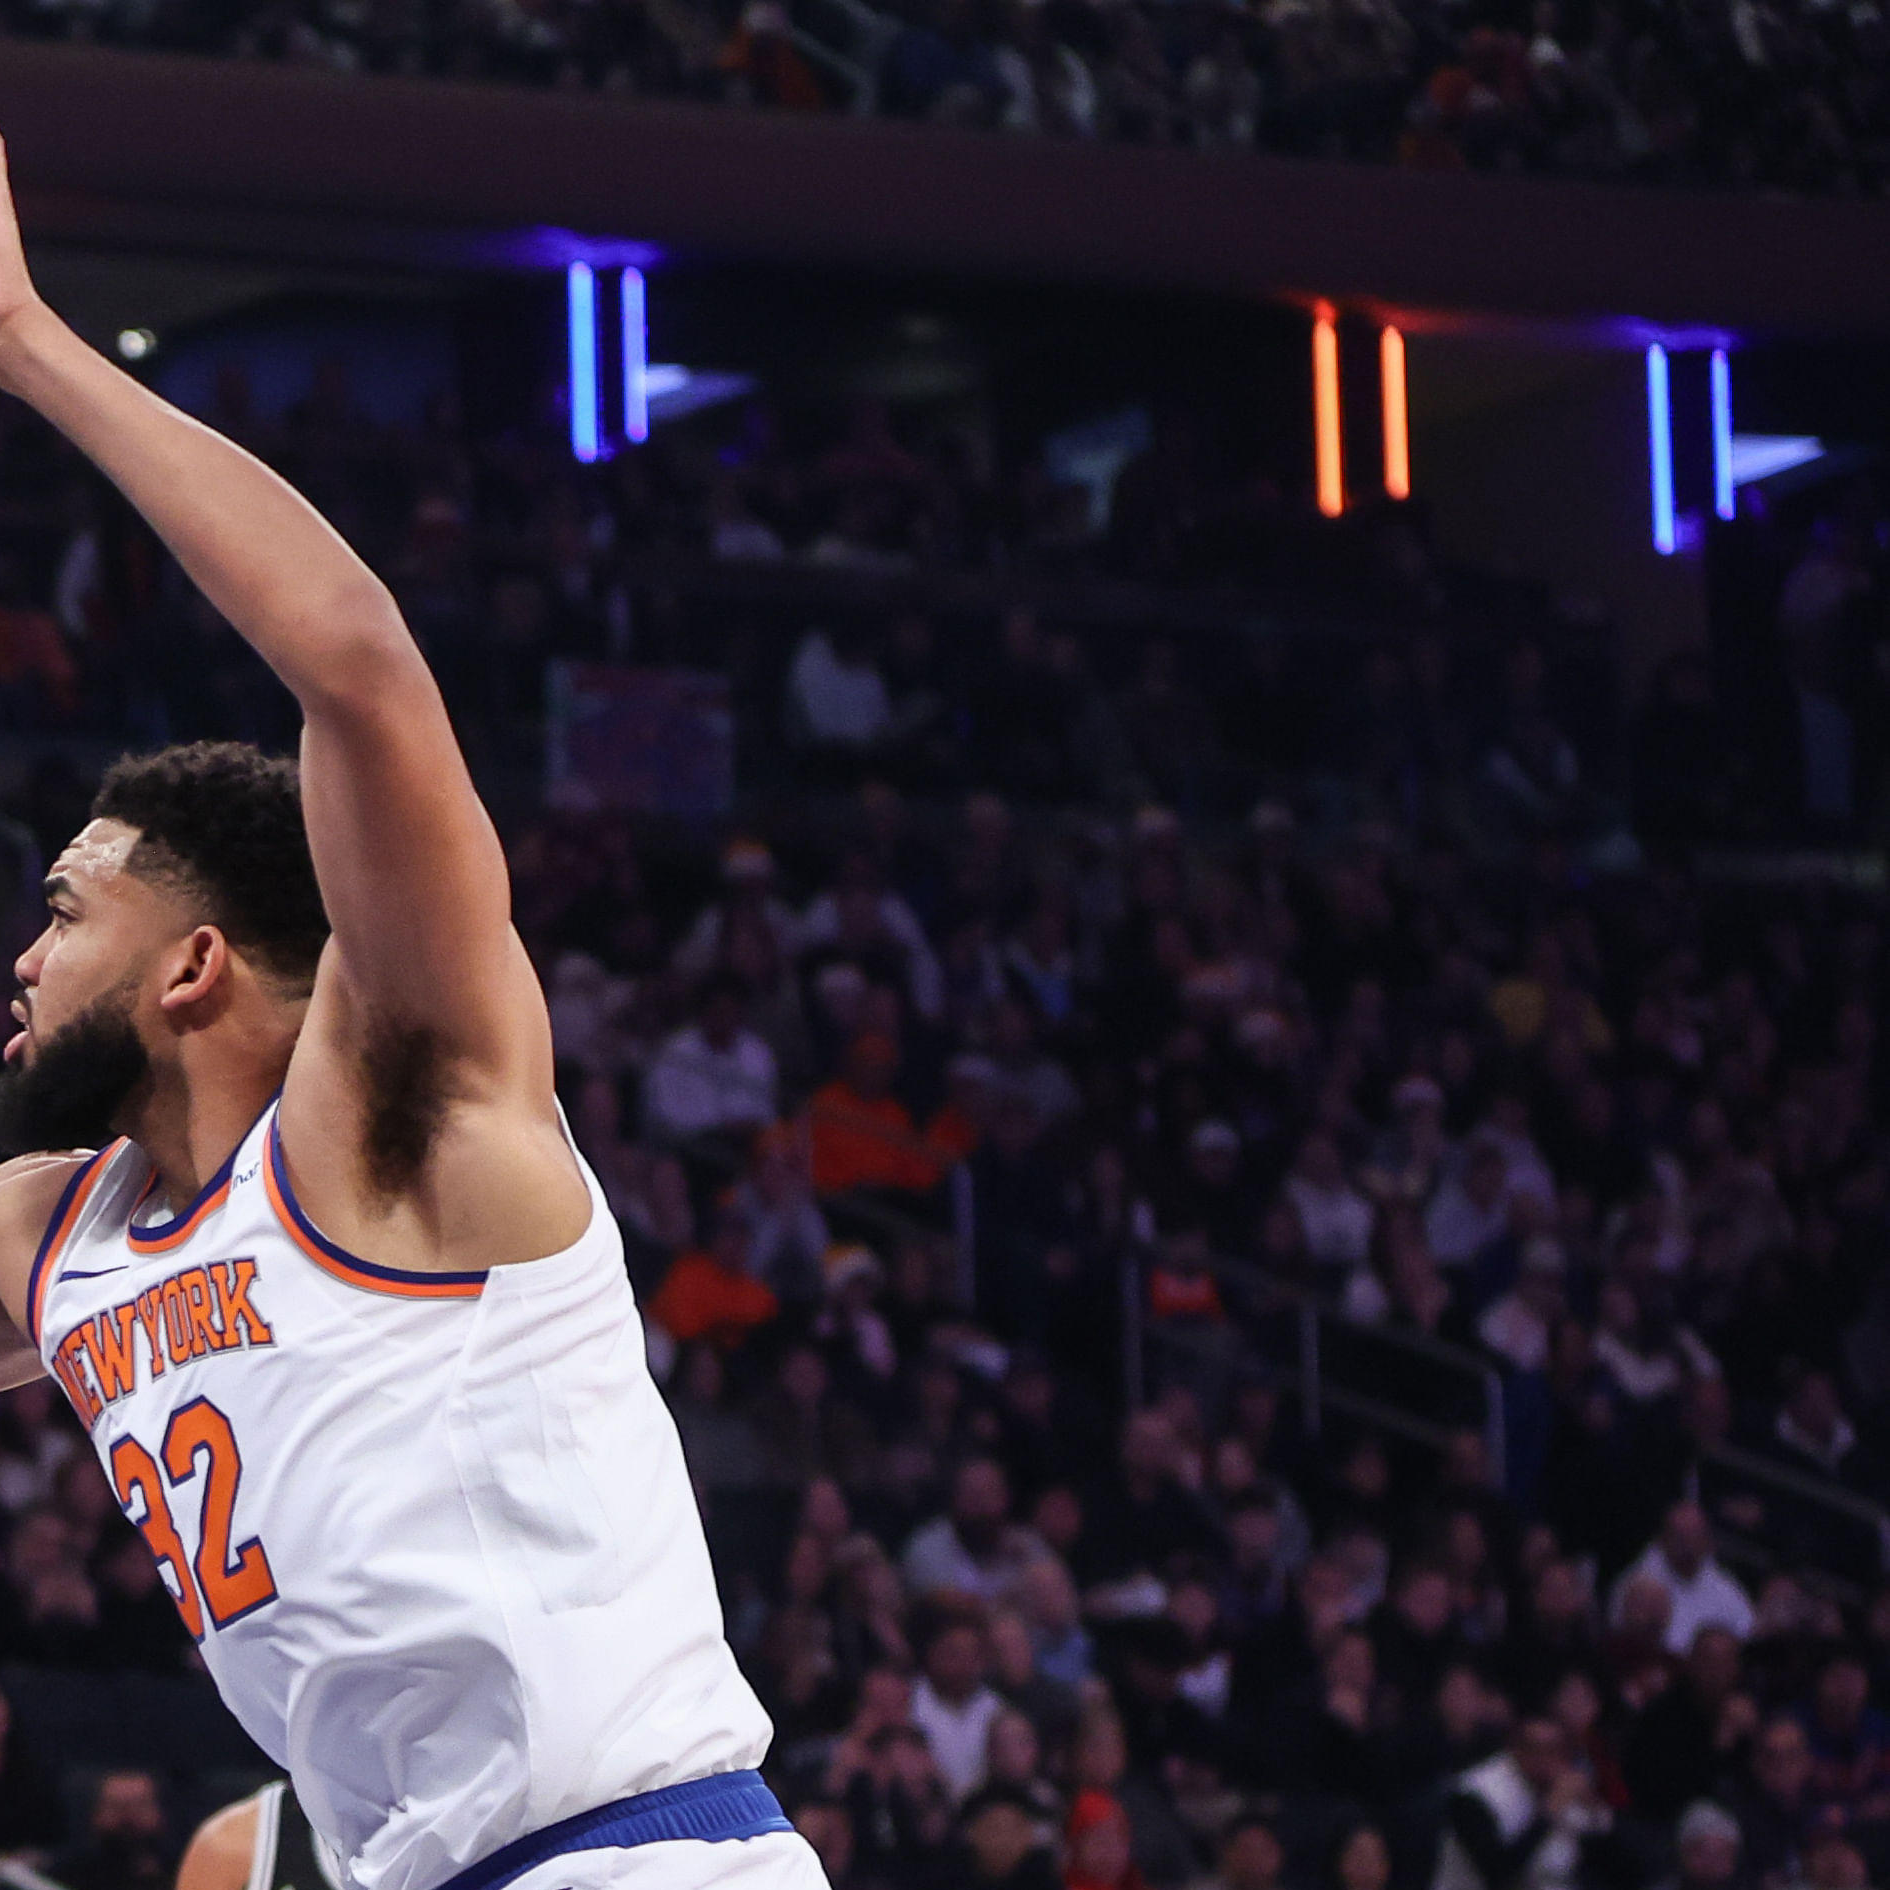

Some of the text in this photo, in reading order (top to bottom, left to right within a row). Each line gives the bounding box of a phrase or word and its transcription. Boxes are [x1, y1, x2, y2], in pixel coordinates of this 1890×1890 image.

[51, 1256, 278, 1434] NEW YORK
[110, 1395, 279, 1645] 32
